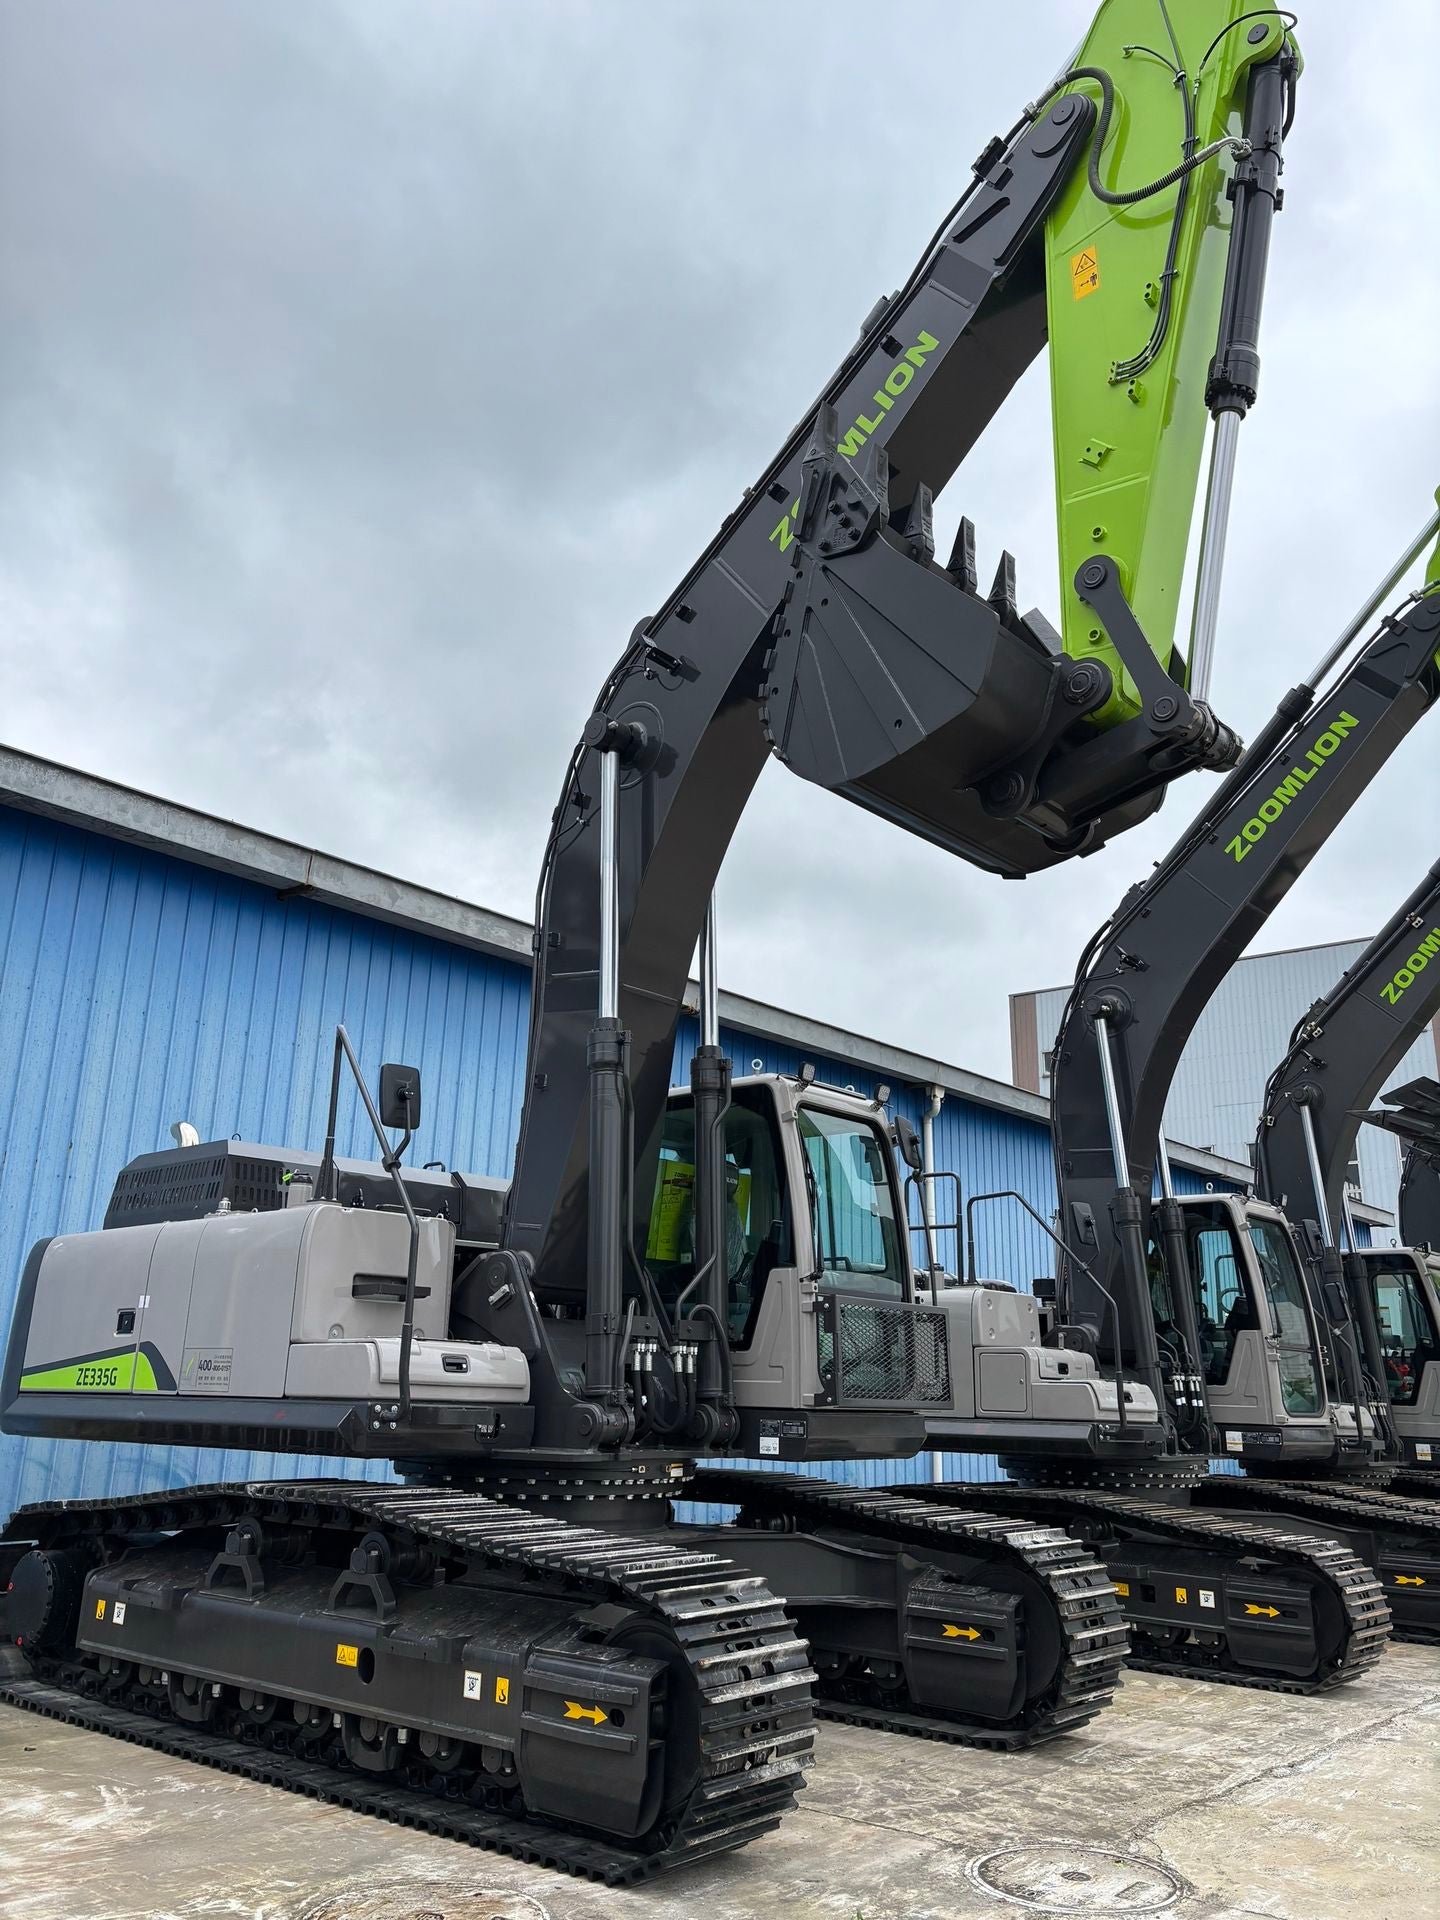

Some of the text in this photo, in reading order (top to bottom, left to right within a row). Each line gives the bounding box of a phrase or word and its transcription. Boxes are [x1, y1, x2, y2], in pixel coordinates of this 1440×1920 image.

[769, 331, 940, 552] ZMLION
[1225, 711, 1360, 862] ZOOMLION
[76, 1367, 118, 1386] ZE335G
